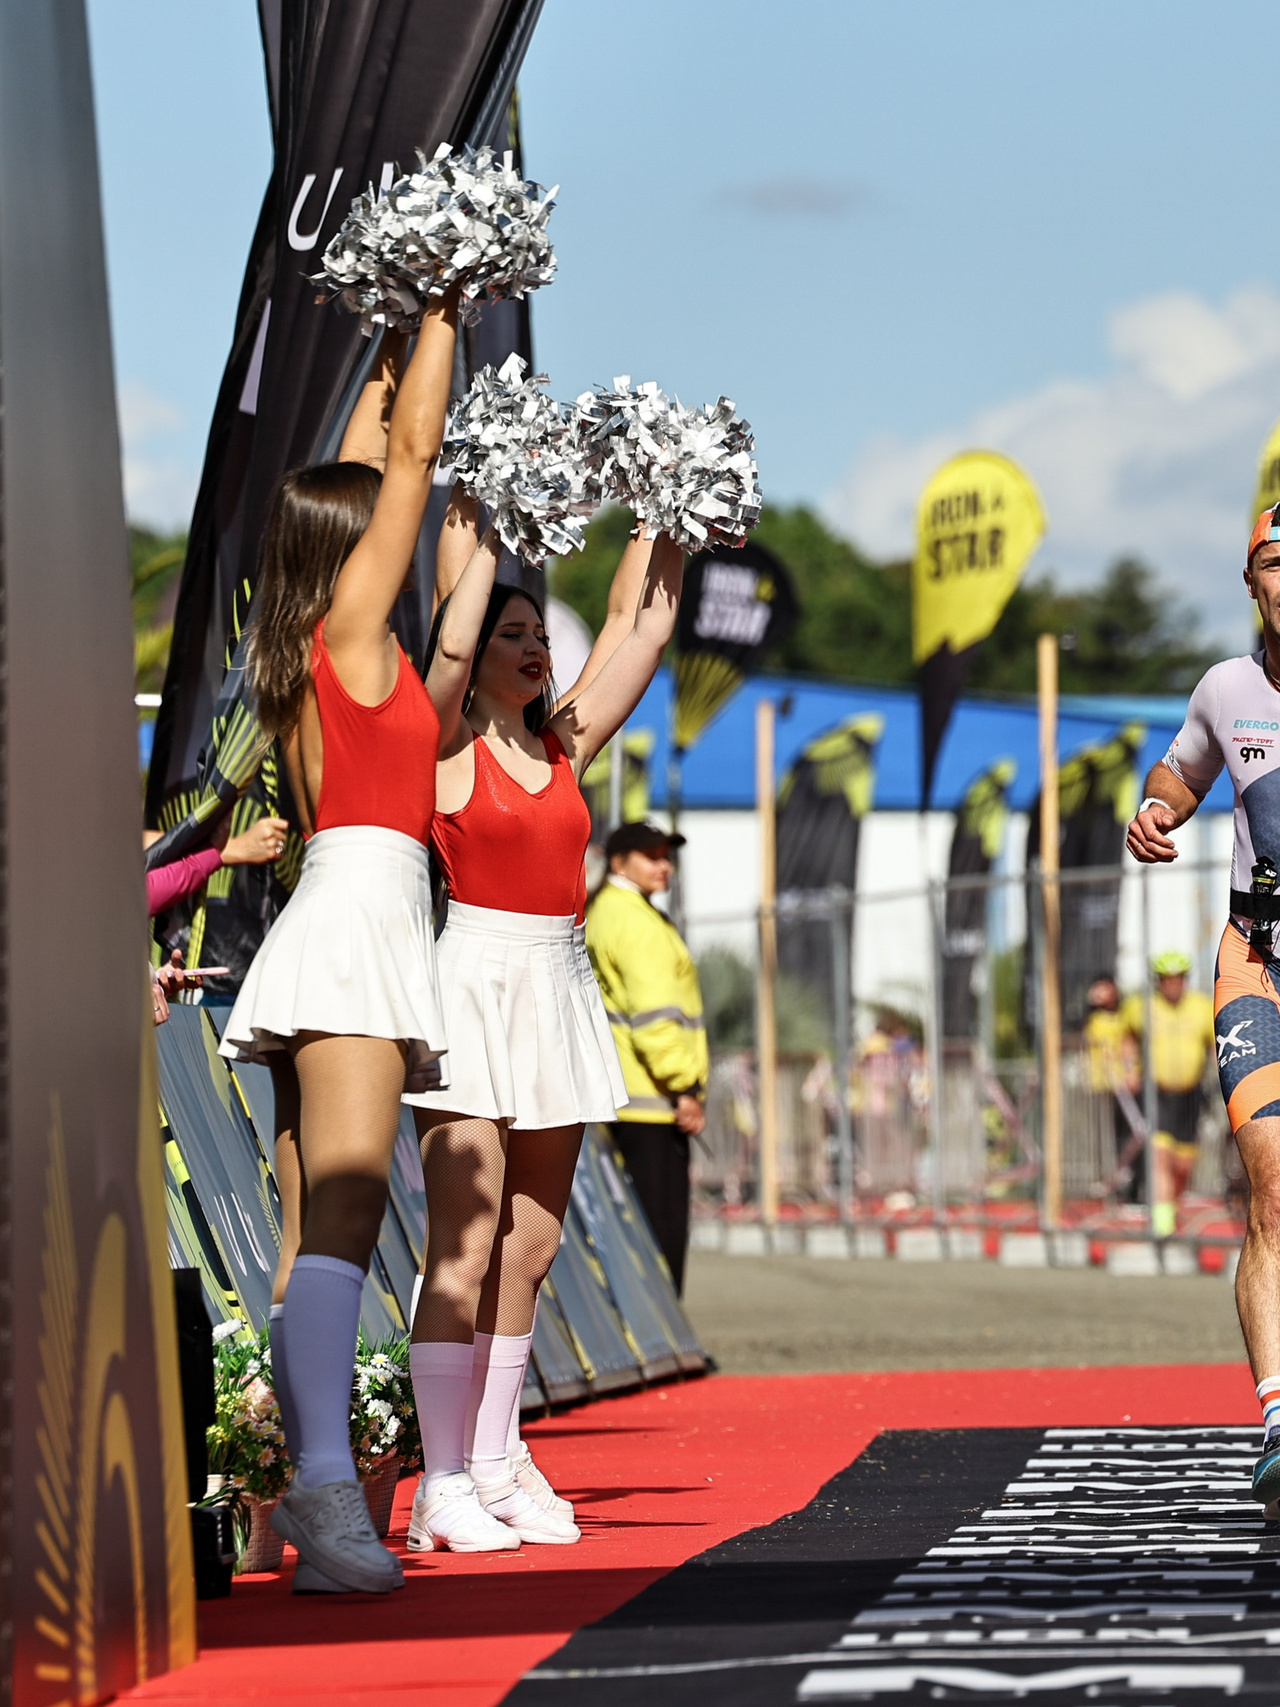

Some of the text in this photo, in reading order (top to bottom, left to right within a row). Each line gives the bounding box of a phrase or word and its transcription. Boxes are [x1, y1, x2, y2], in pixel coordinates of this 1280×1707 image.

[1233, 719, 1279, 731] EVERGO
[1240, 747, 1265, 764] gm
[1218, 1047, 1256, 1068] EAM
